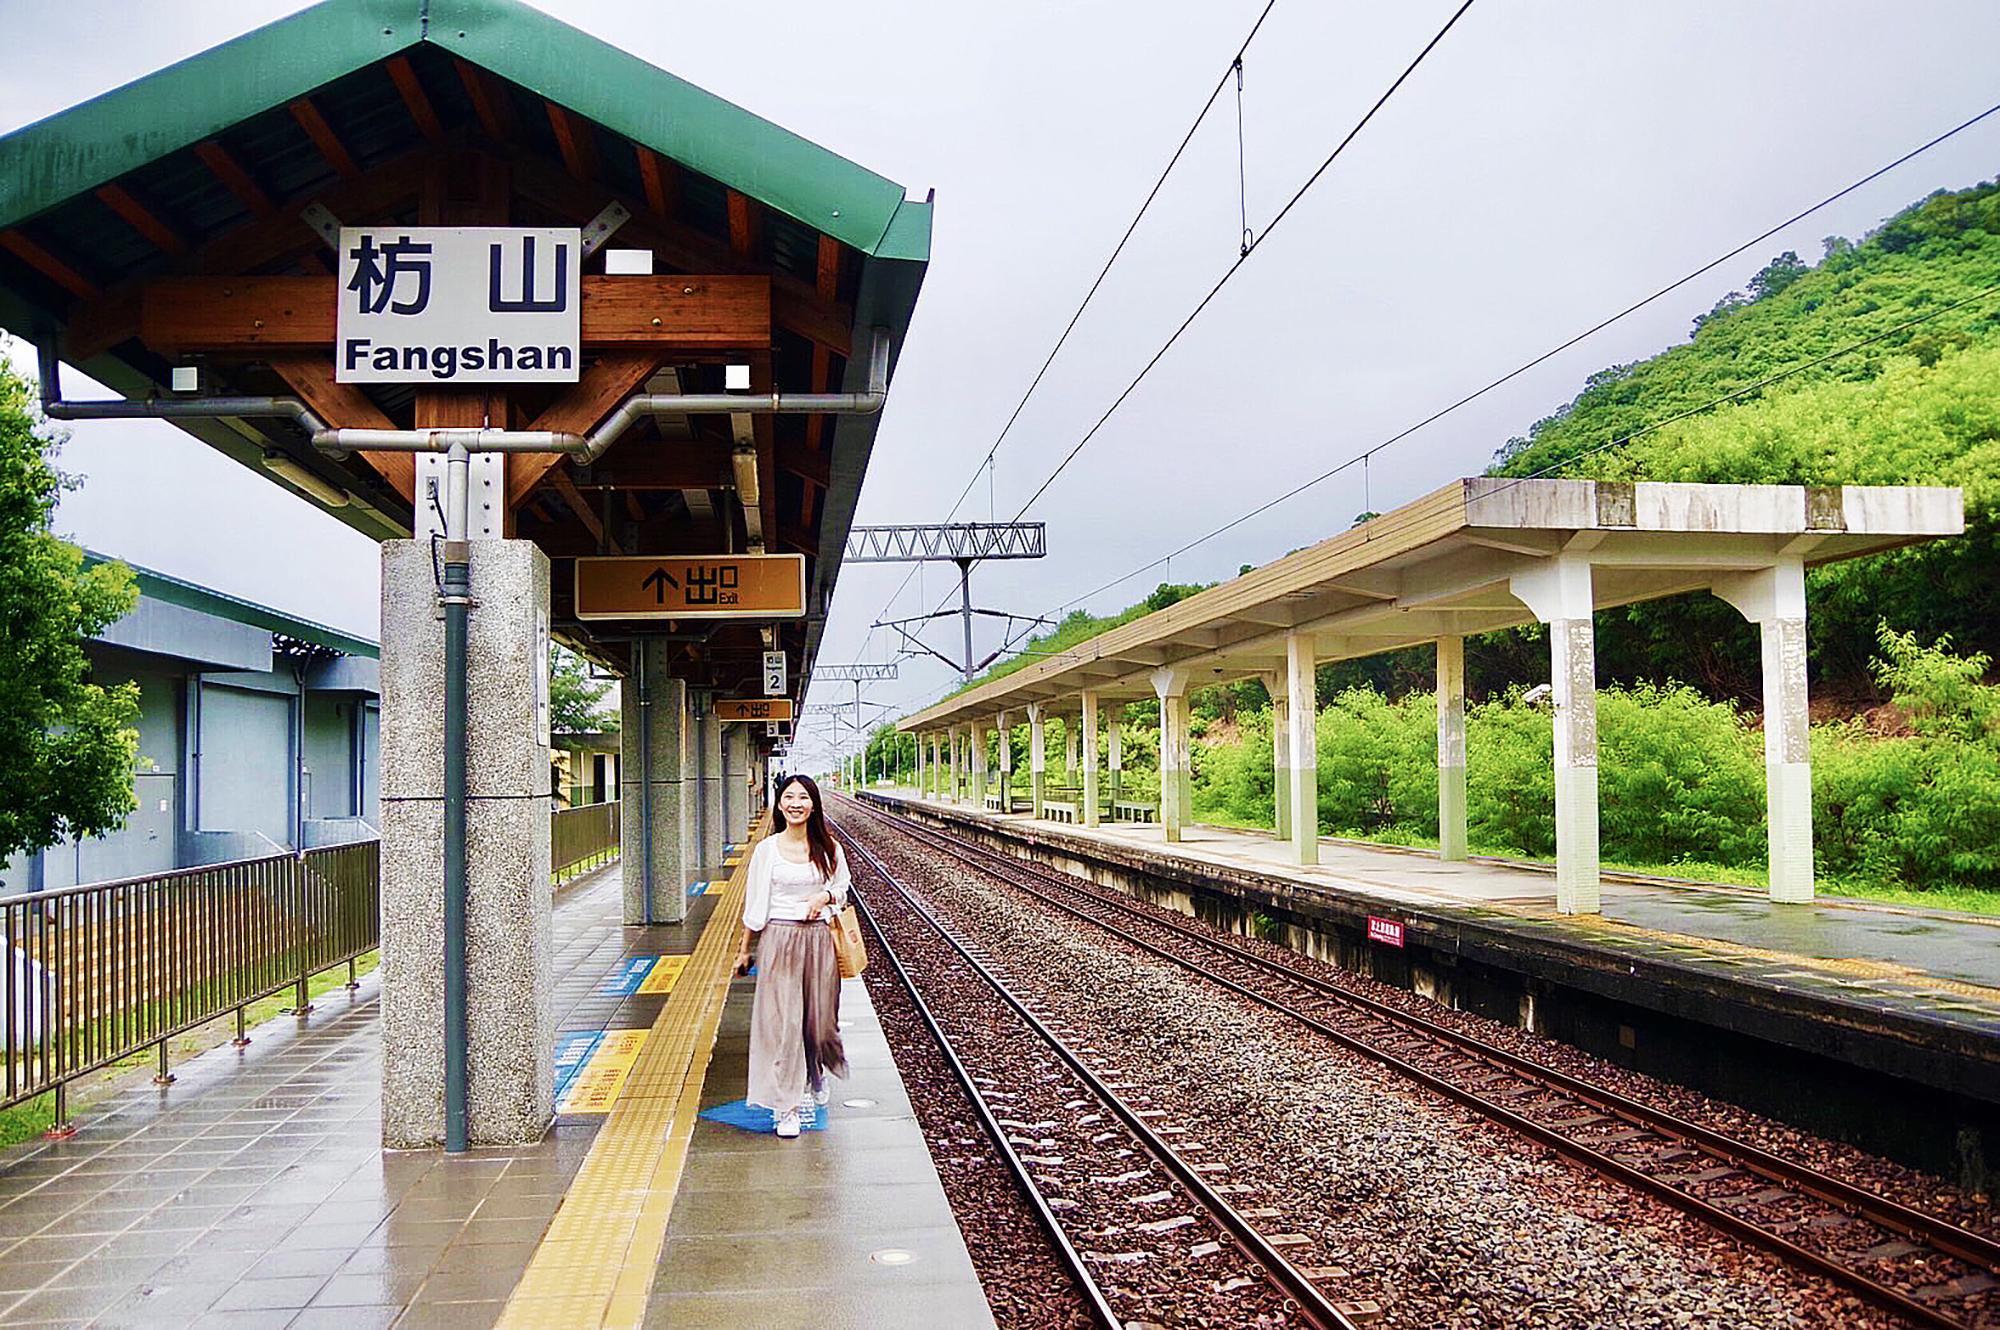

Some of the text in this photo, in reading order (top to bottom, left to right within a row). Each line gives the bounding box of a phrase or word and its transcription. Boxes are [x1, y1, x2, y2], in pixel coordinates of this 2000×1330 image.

[346, 235, 568, 316] 枋山
[345, 338, 572, 379] Fangshan
[685, 565, 738, 605] 出口
[719, 591, 739, 605] Exit
[770, 674, 781, 690] 2
